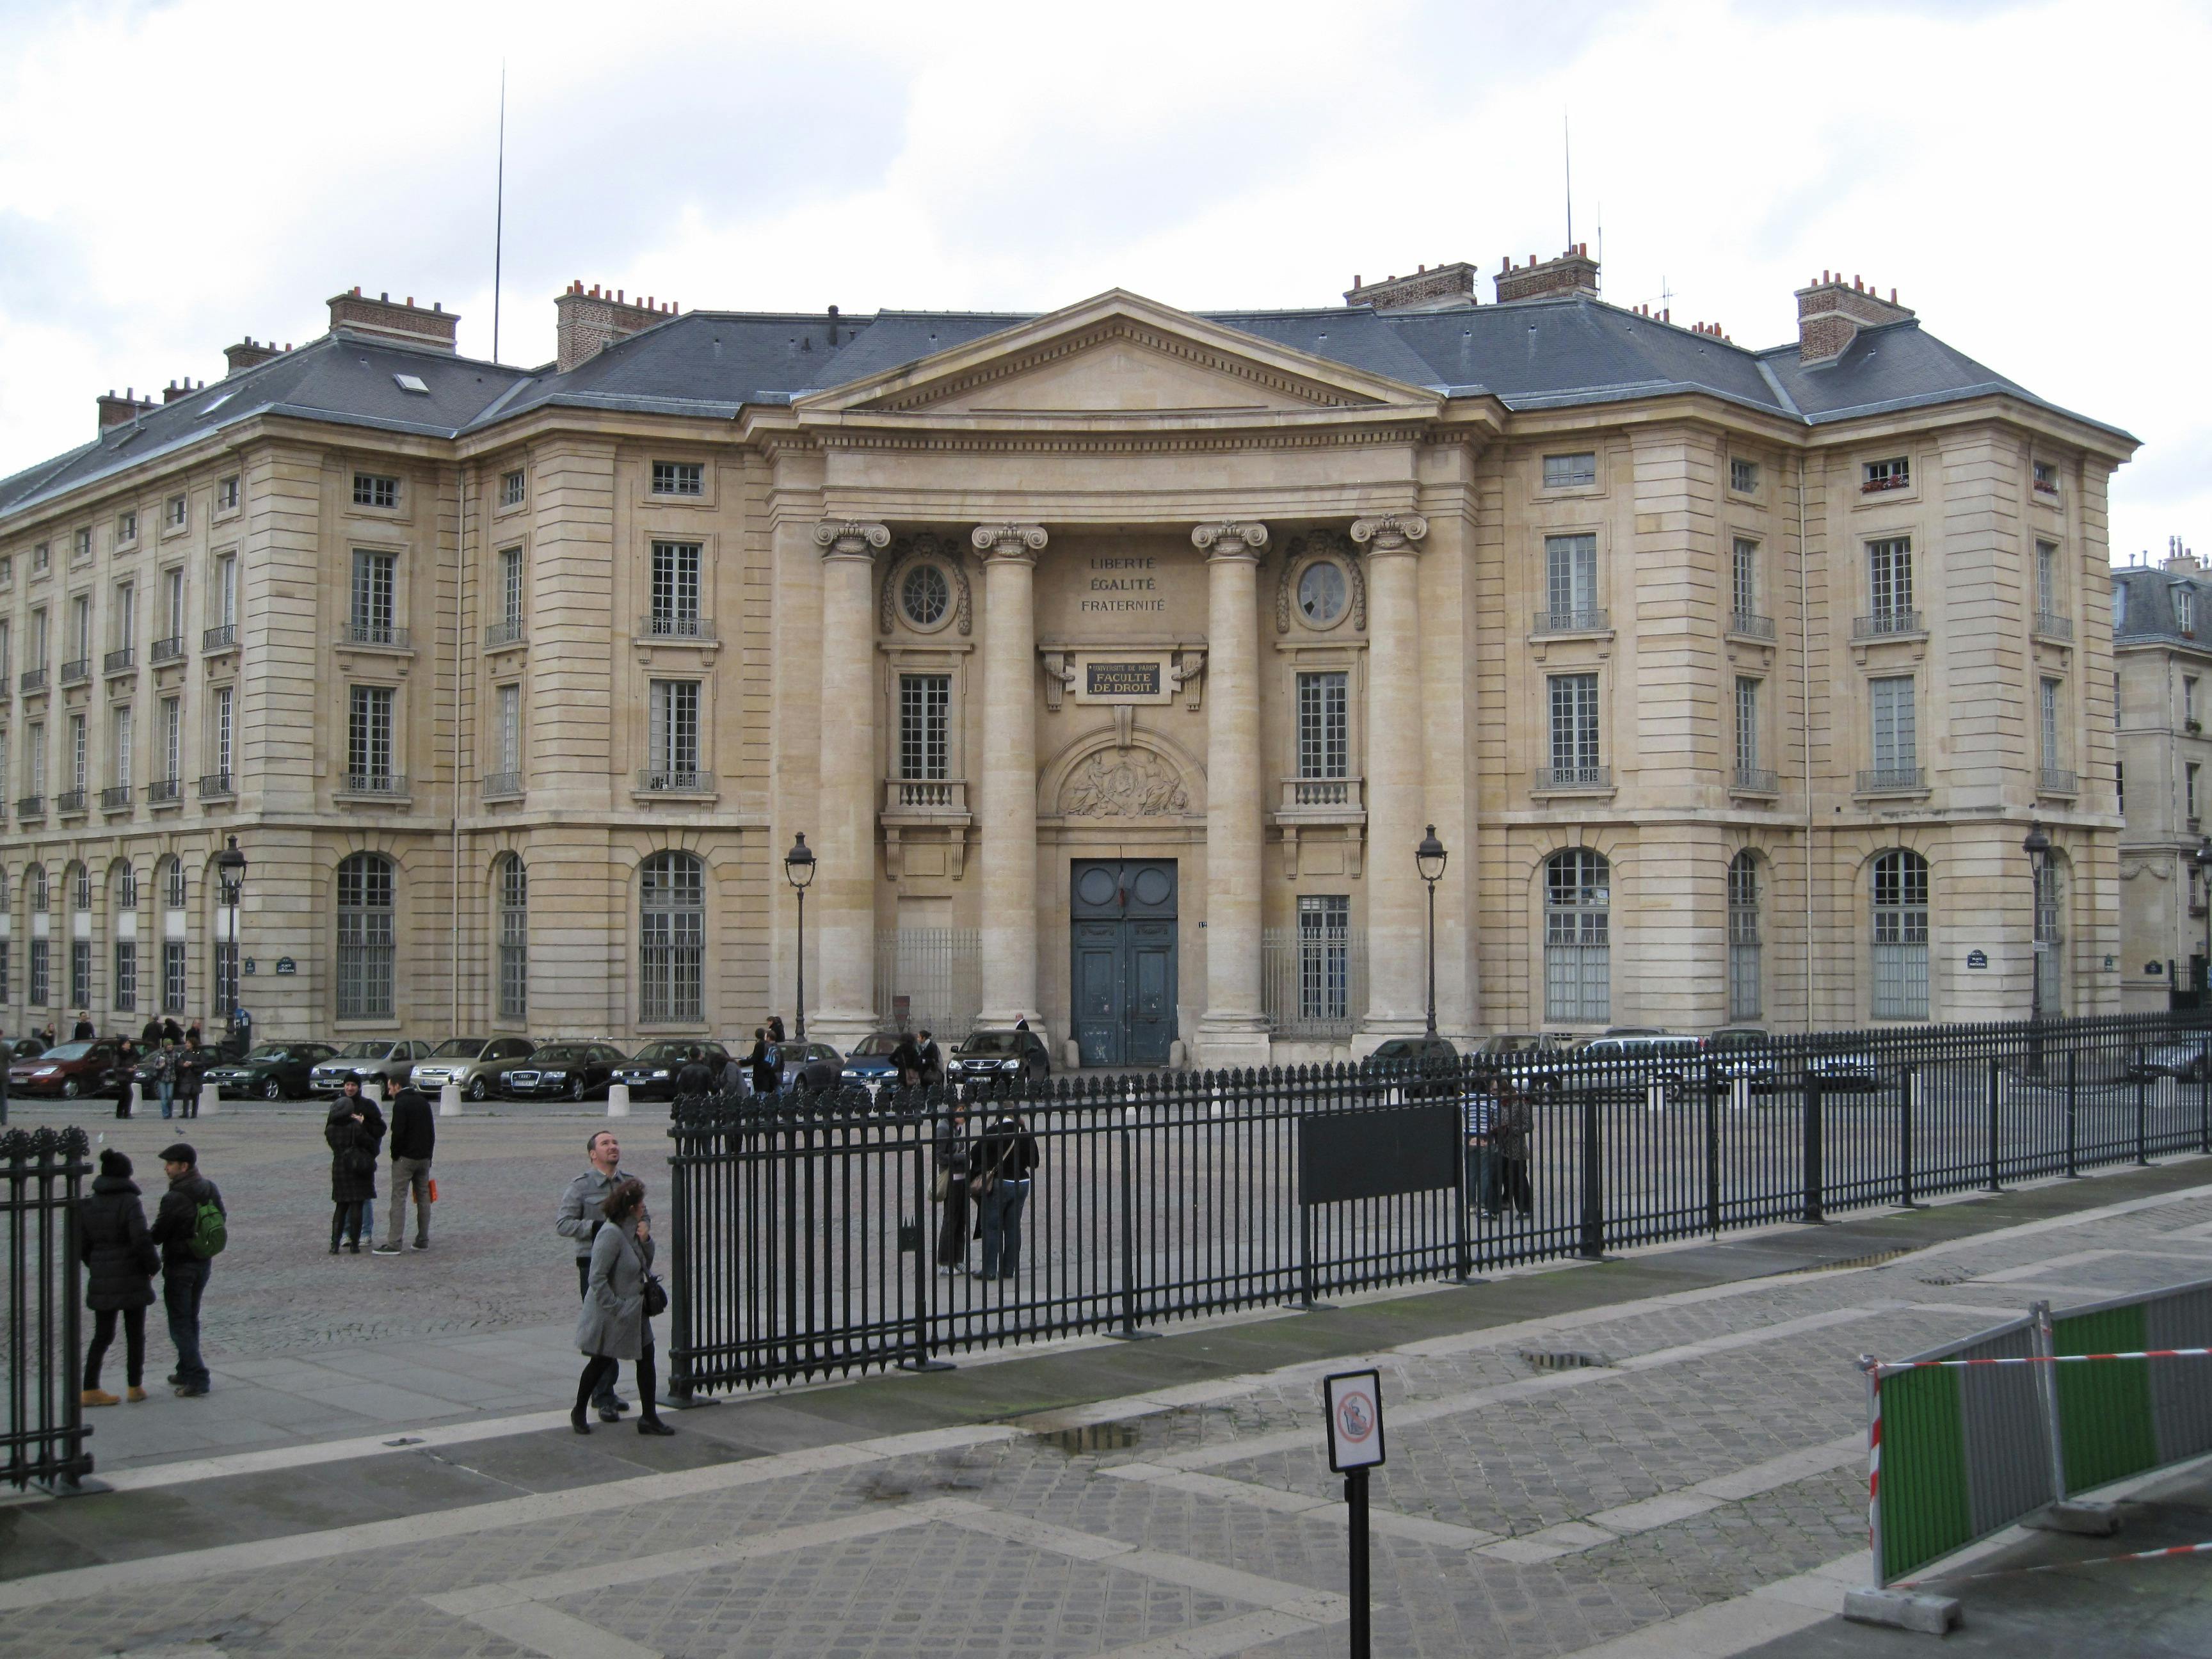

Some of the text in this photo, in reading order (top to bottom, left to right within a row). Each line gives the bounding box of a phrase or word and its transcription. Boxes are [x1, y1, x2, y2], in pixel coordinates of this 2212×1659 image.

[1091, 557, 1157, 569] LIBERTÉ
[1091, 577, 1156, 590] ÉGALITÉ
[1081, 598, 1166, 611] FRATERNITÉ
[1093, 683, 1152, 692] DE DROIT
